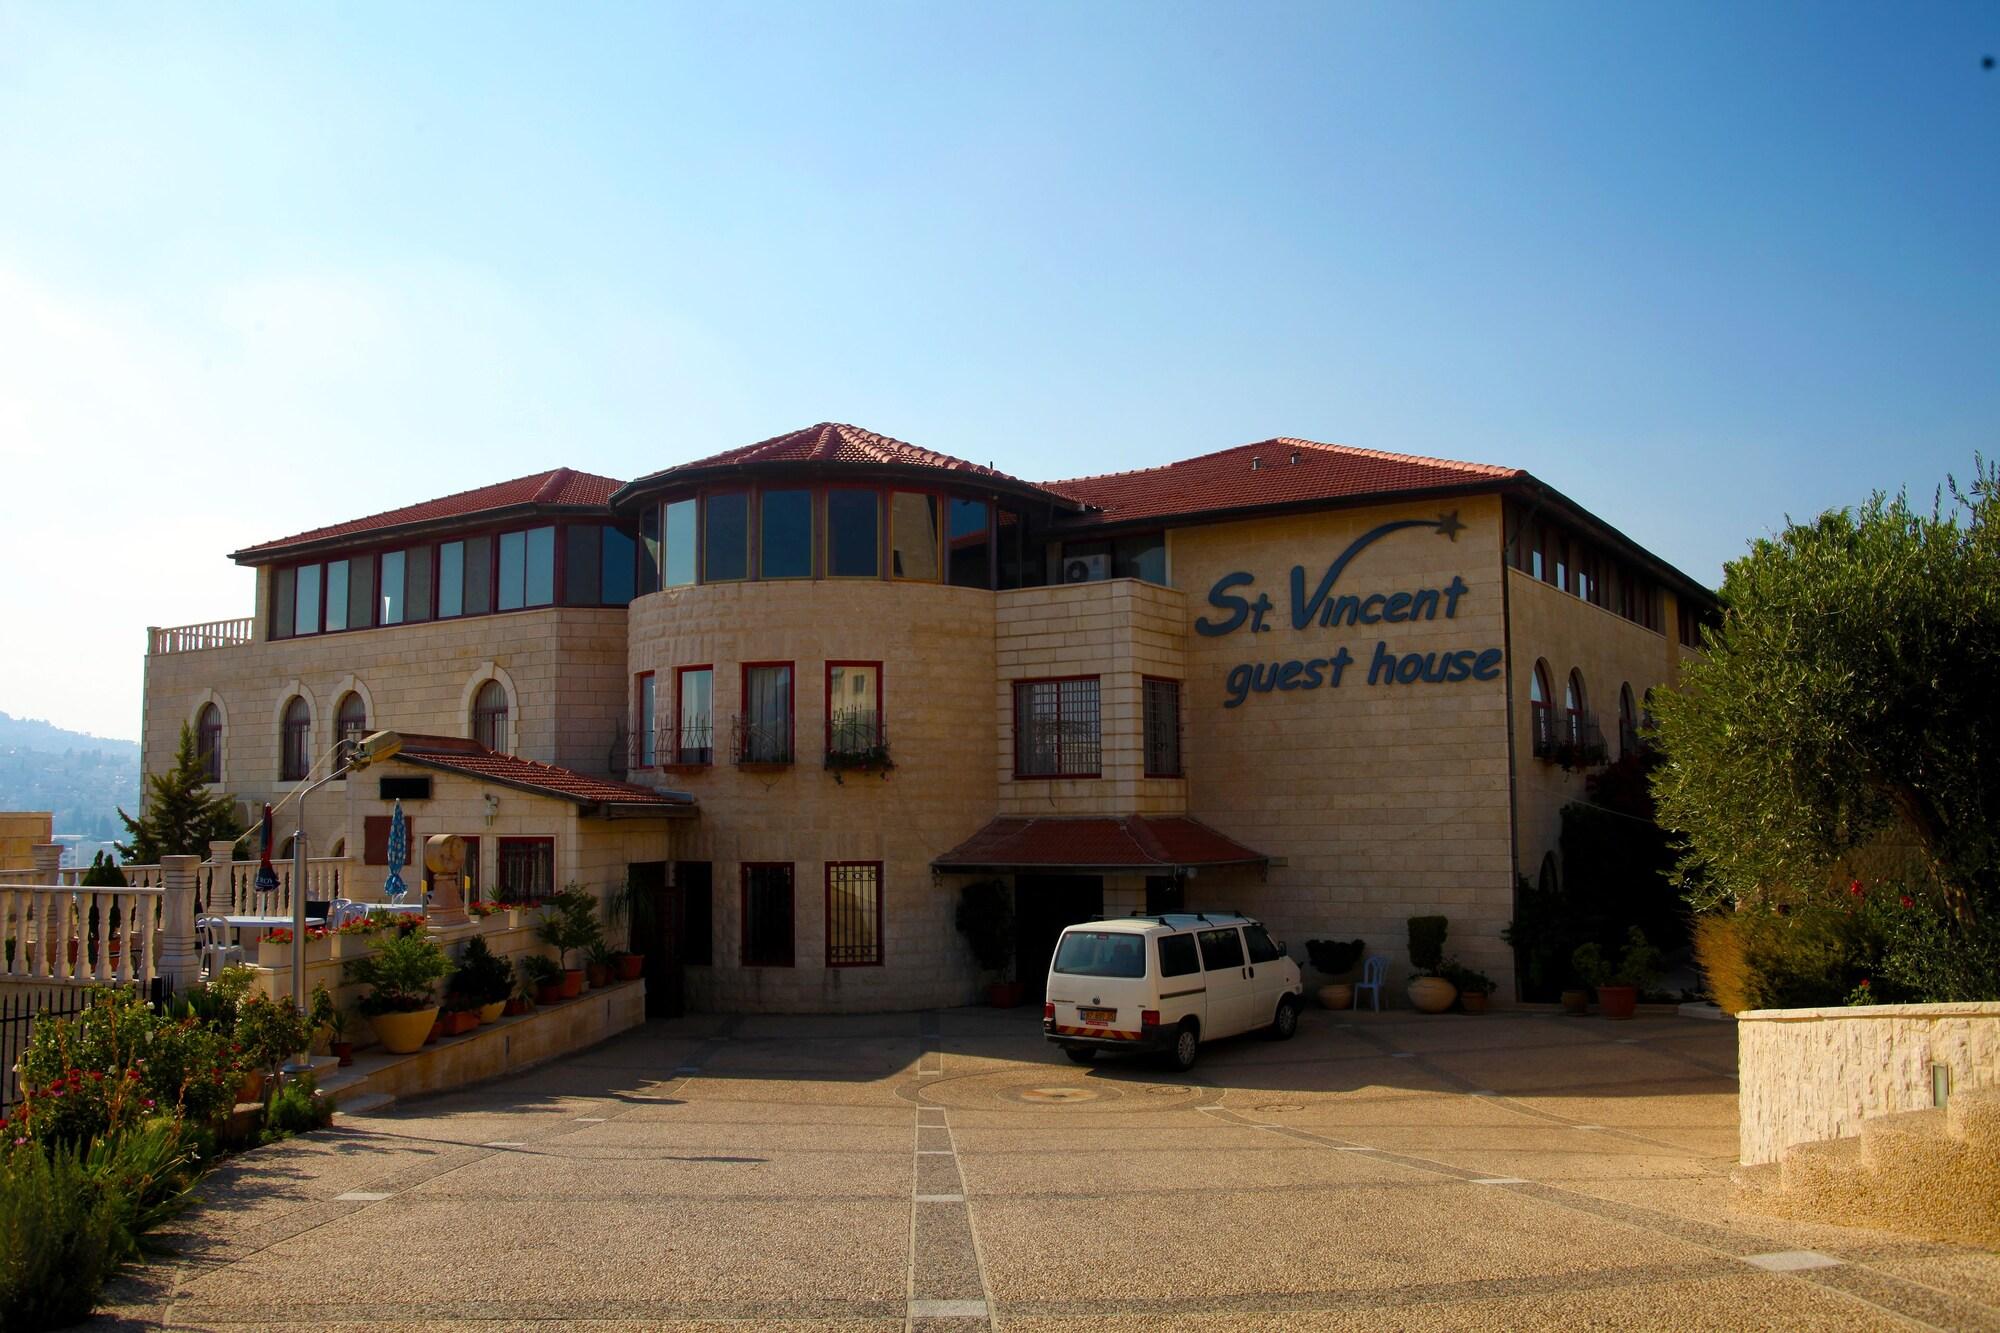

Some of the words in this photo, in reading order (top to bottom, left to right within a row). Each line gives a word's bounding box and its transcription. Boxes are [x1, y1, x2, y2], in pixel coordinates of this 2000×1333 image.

[1195, 572, 1272, 636] St.
[1290, 520, 1468, 630] Vincent
[1224, 647, 1353, 708] guest
[1368, 641, 1503, 686] house
